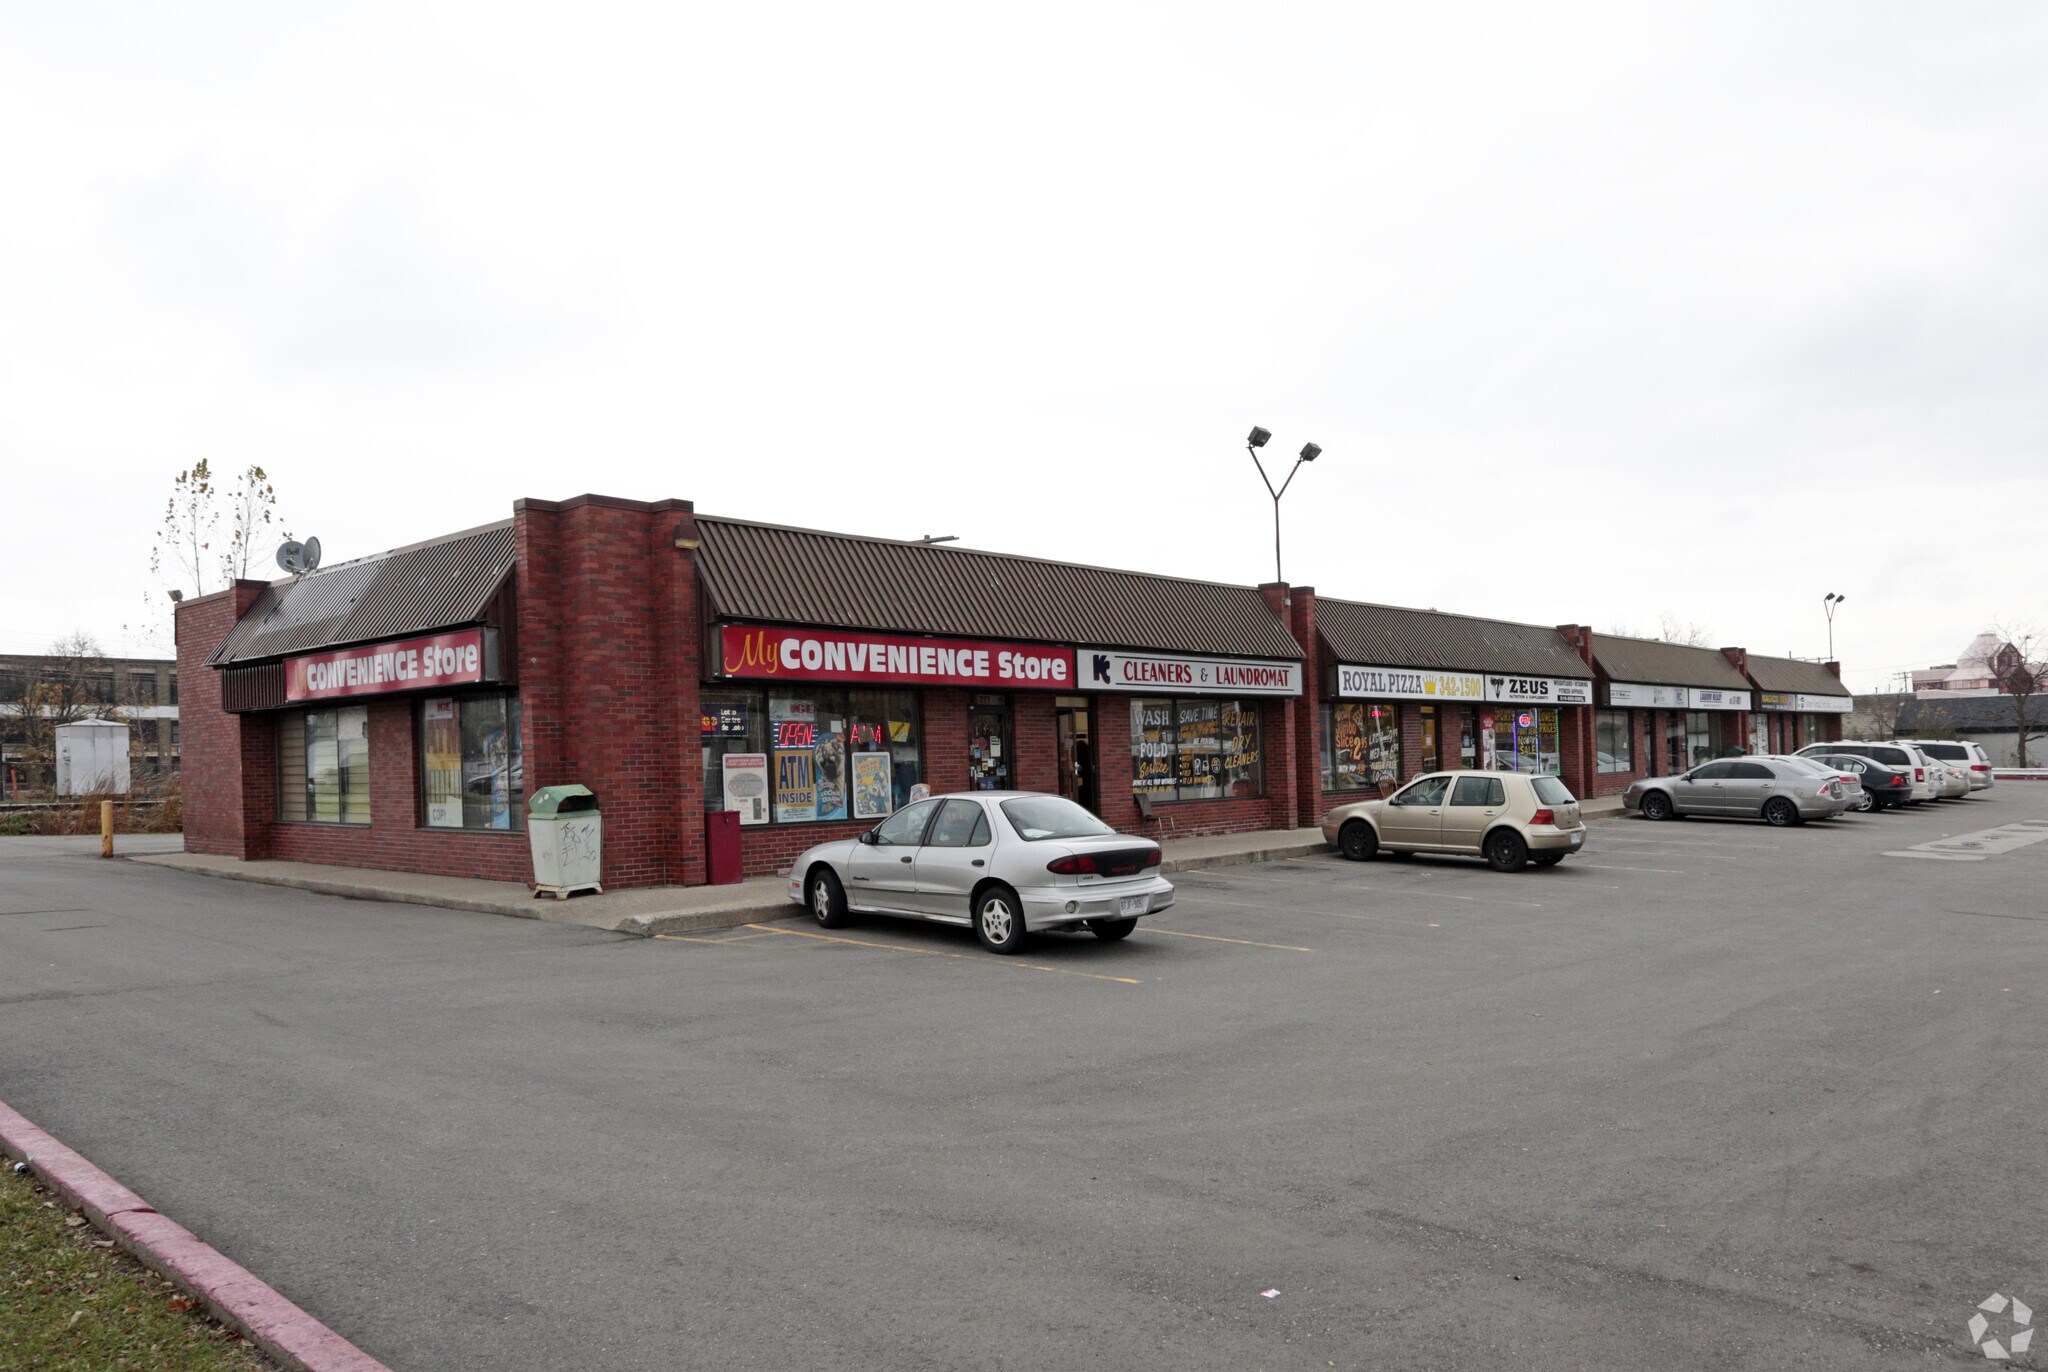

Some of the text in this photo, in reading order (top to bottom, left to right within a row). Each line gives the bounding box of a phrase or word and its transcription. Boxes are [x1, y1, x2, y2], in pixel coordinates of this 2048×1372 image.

[724, 631, 1067, 681] My CONVENIENCE Store
[307, 649, 418, 691] CONVENIENCE
[423, 644, 478, 678] Store
[1124, 661, 1290, 687] CLEANERS & LAUNDROMAT
[1342, 670, 1481, 697] ROYAL PIZZA 342-1500
[1509, 679, 1548, 695] ZEUS
[1134, 710, 1169, 726] WASH
[1179, 706, 1218, 724] SAVE TIME
[1223, 711, 1255, 727] REPAIR
[779, 723, 813, 746] OPEN
[850, 724, 882, 744] AM
[1231, 733, 1252, 752] DRY
[1140, 742, 1168, 758] FOLD
[1224, 750, 1259, 769] CLEANERS
[1520, 745, 1536, 755] SALE
[779, 755, 810, 790] ATM
[1139, 761, 1169, 779] Service
[779, 792, 812, 804] INSIDE
